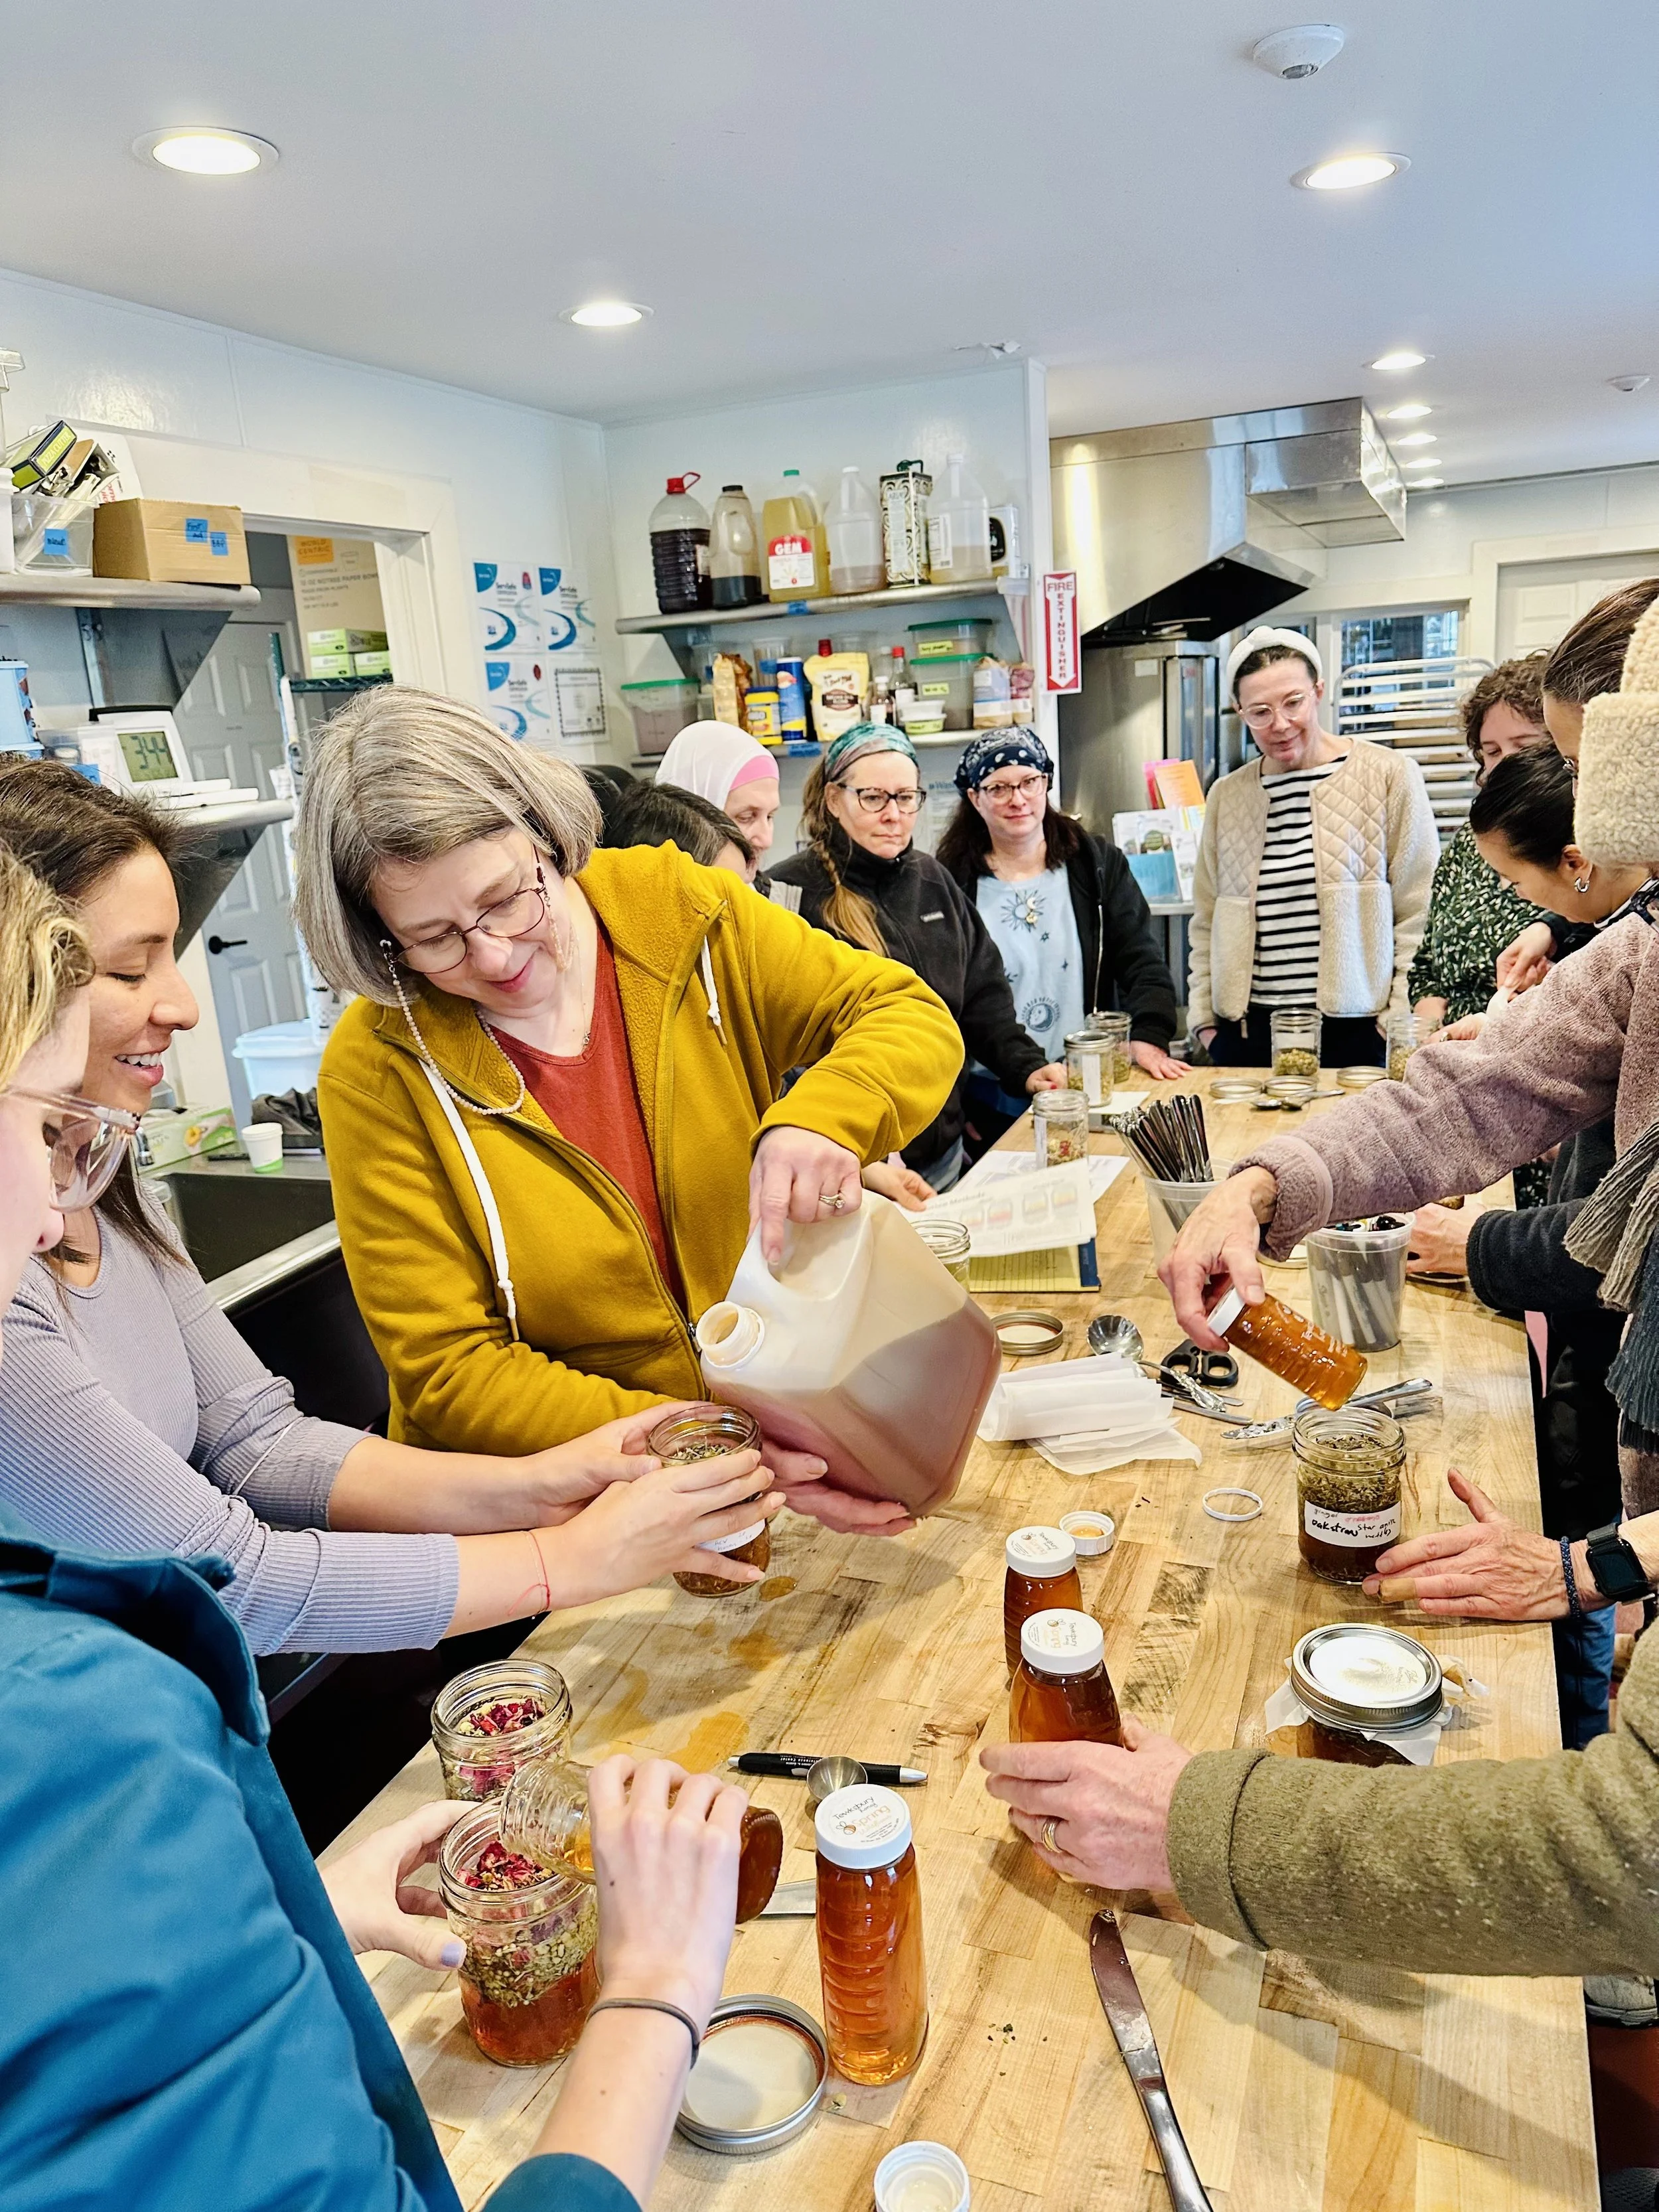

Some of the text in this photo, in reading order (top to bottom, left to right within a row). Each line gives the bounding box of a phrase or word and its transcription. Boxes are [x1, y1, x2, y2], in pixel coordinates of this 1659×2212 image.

[774, 542, 802, 555] GEM
[1047, 581, 1073, 592] FIRE
[1056, 593, 1066, 678] EXTINGUISHER
[1358, 1523, 1376, 1532] Star
[833, 1796, 875, 1820] Tewksbury
[851, 1805, 891, 1827] Spring
